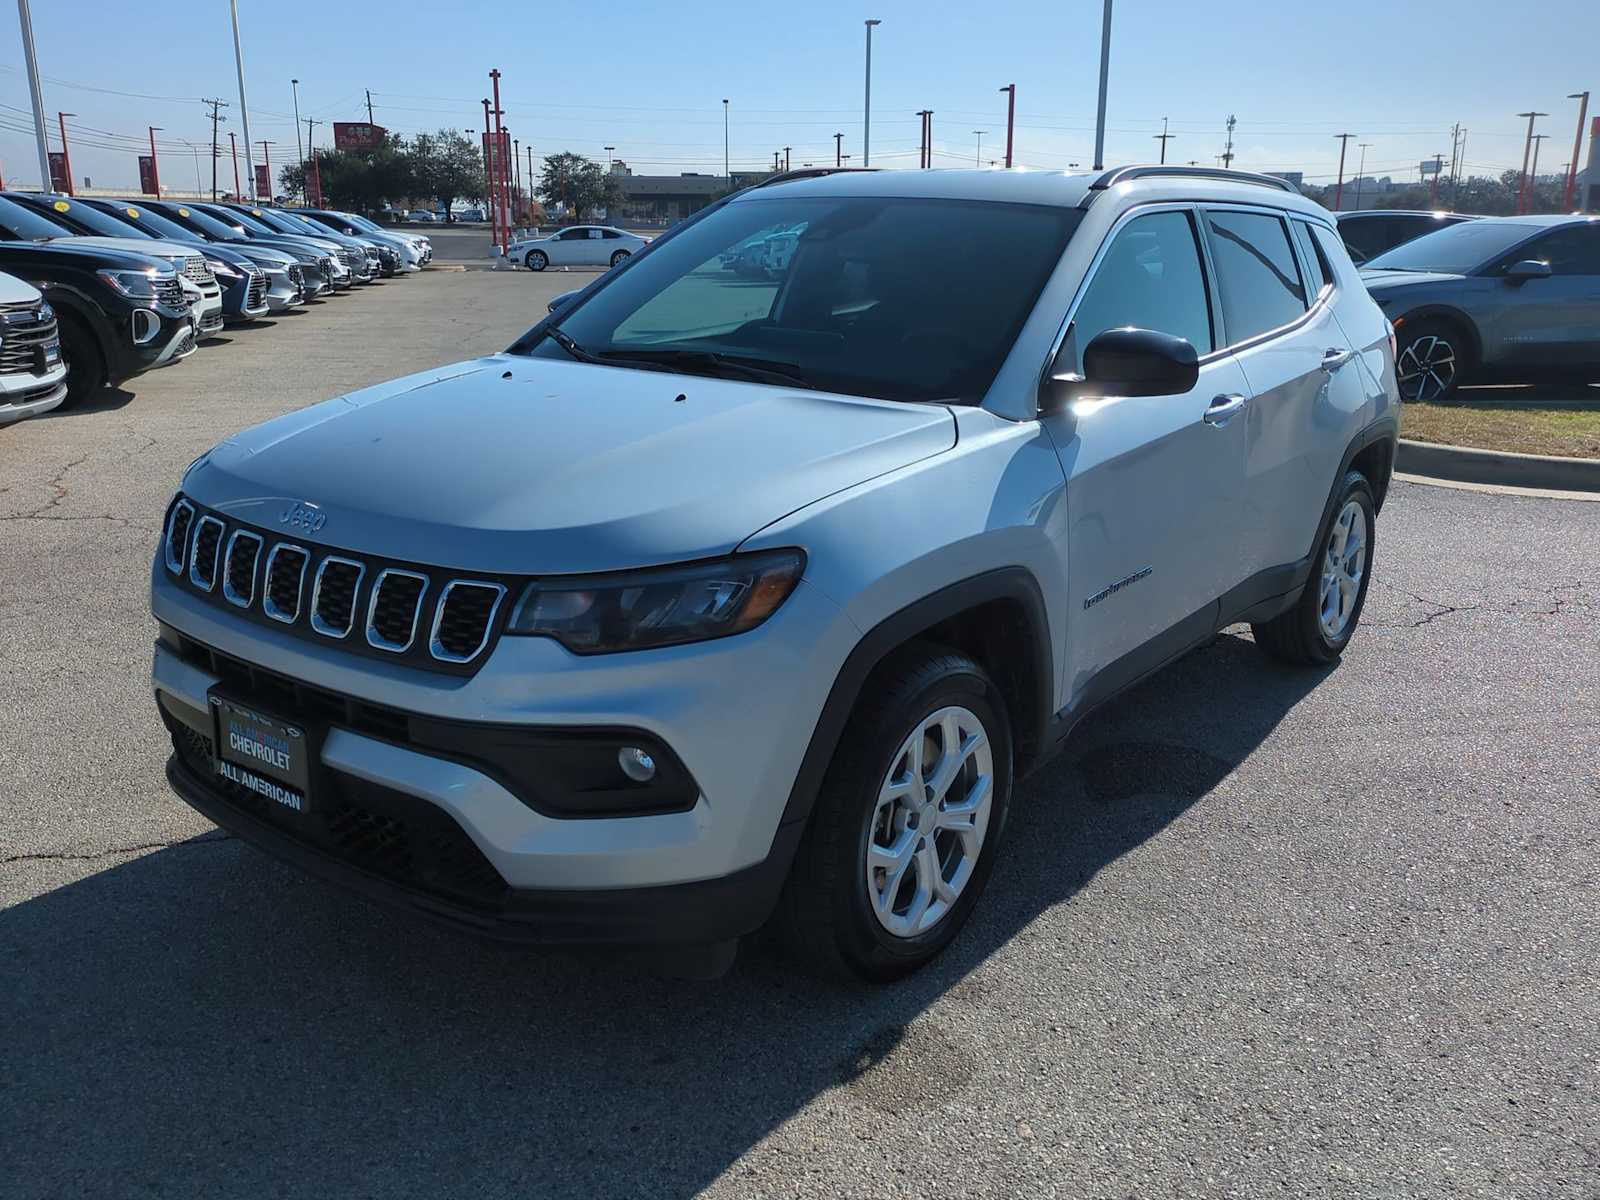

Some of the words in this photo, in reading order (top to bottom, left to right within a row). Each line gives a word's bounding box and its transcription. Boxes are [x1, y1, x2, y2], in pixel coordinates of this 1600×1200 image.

[230, 732, 290, 770] CHEVROLET
[220, 762, 240, 783] ALL
[241, 772, 301, 811] AMERICAN
